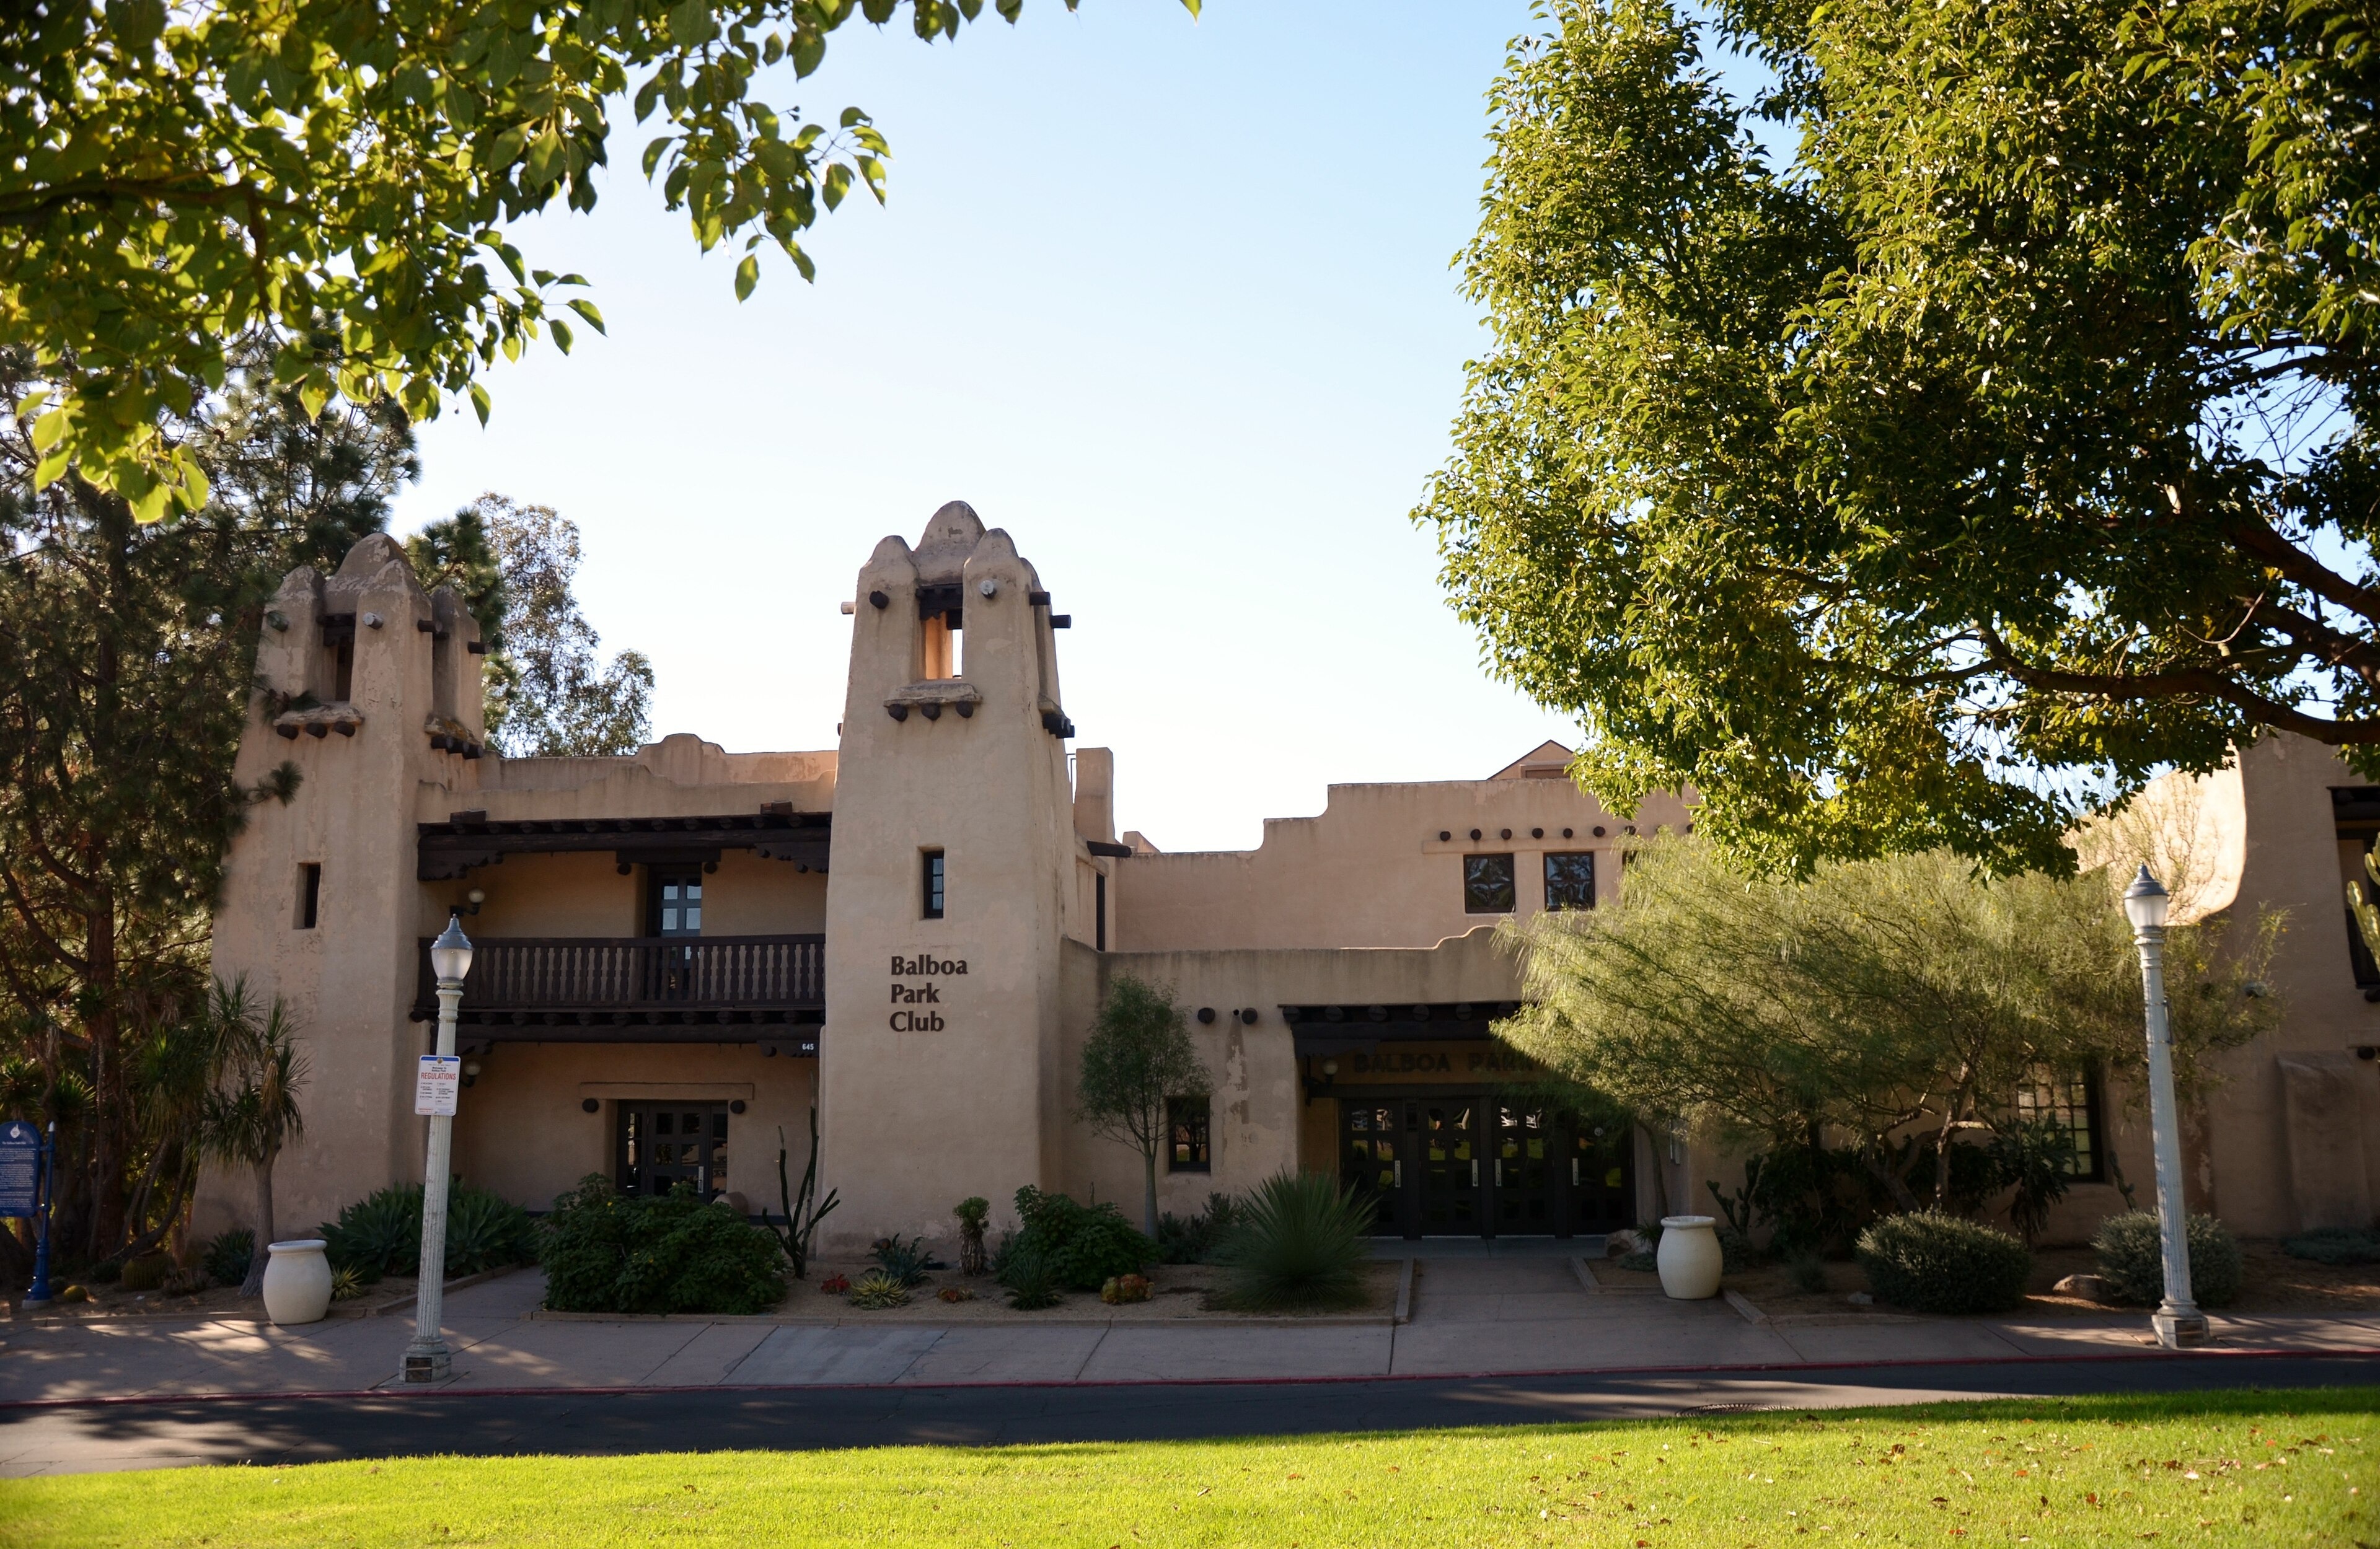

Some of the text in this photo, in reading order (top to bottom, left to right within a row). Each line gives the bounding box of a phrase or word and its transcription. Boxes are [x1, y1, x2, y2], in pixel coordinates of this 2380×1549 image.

[891, 954, 968, 975] Balboa
[891, 983, 940, 1004] Park
[889, 1011, 945, 1032] Club
[1355, 1053, 1451, 1072] BALBOA
